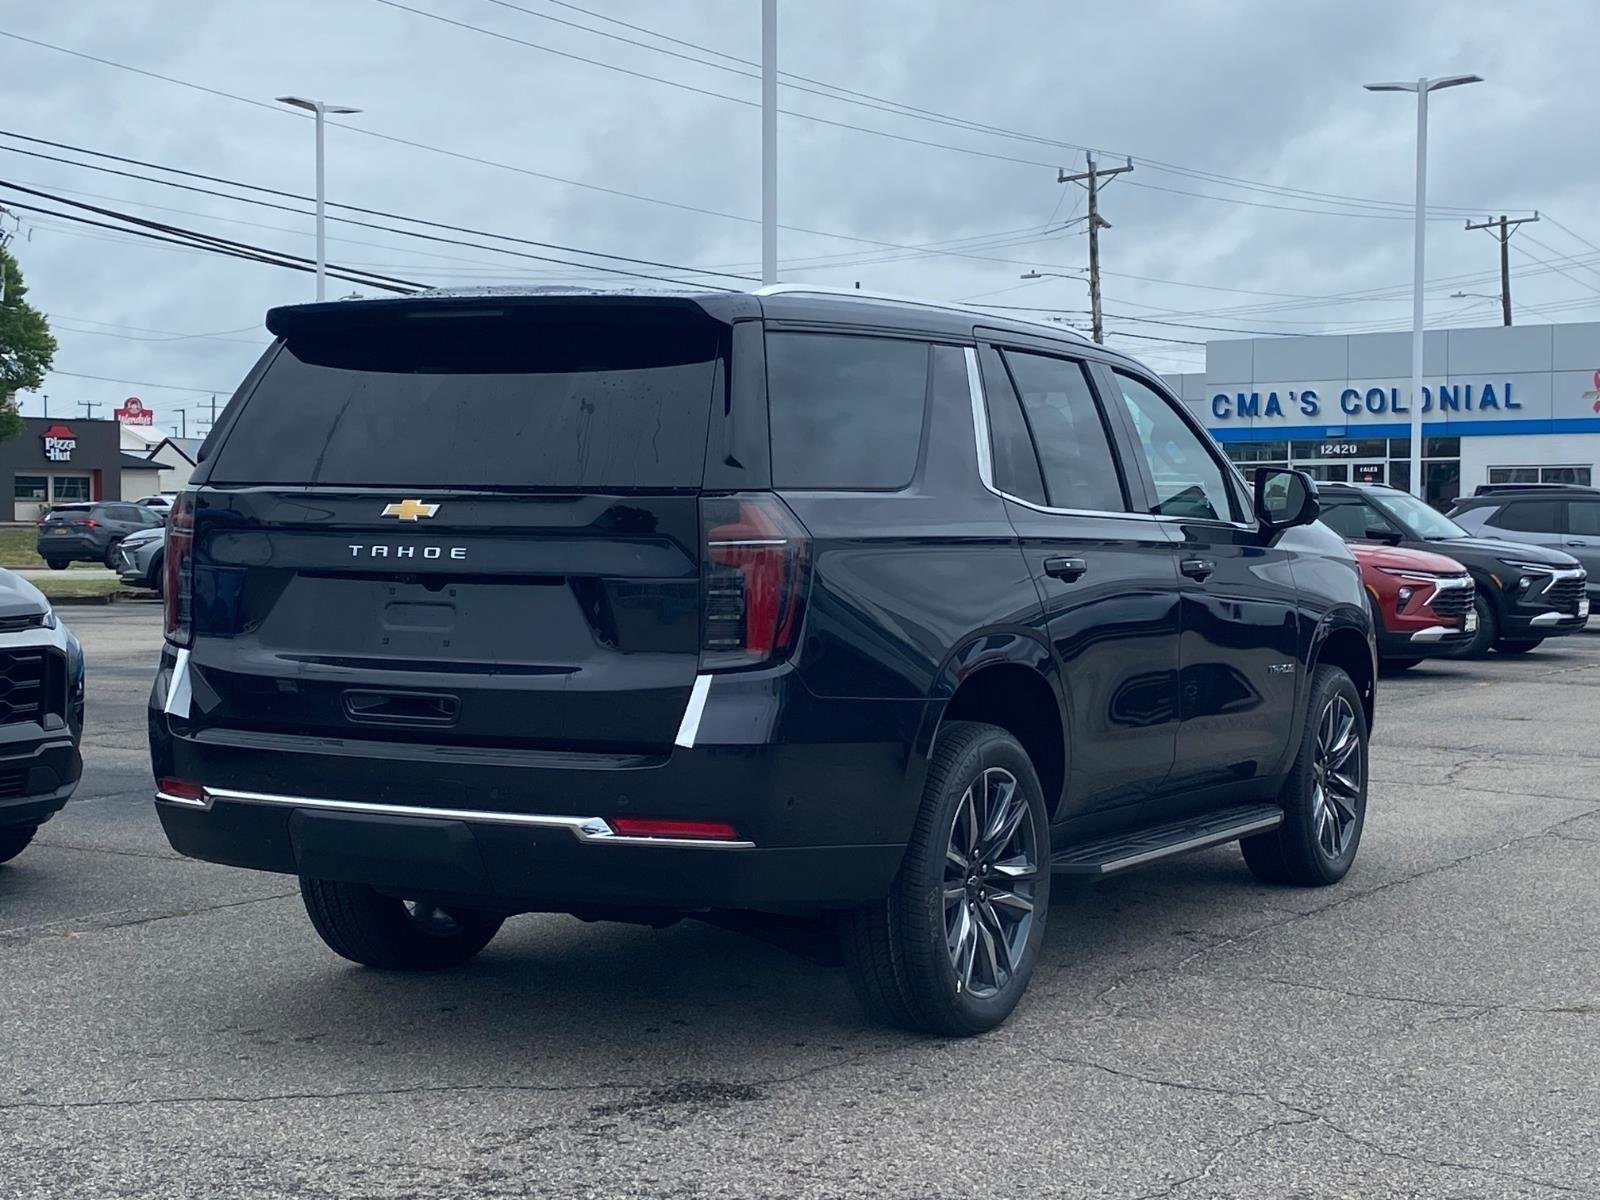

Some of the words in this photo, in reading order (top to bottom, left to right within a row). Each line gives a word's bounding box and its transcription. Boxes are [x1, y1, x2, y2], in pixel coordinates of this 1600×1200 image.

[1212, 390, 1319, 419] CMA'S
[1340, 383, 1522, 415] COLONIAL
[45, 436, 76, 450] Pizza
[1320, 444, 1358, 455] 12420
[46, 448, 71, 461] Hut
[348, 544, 467, 560] TAHOE
